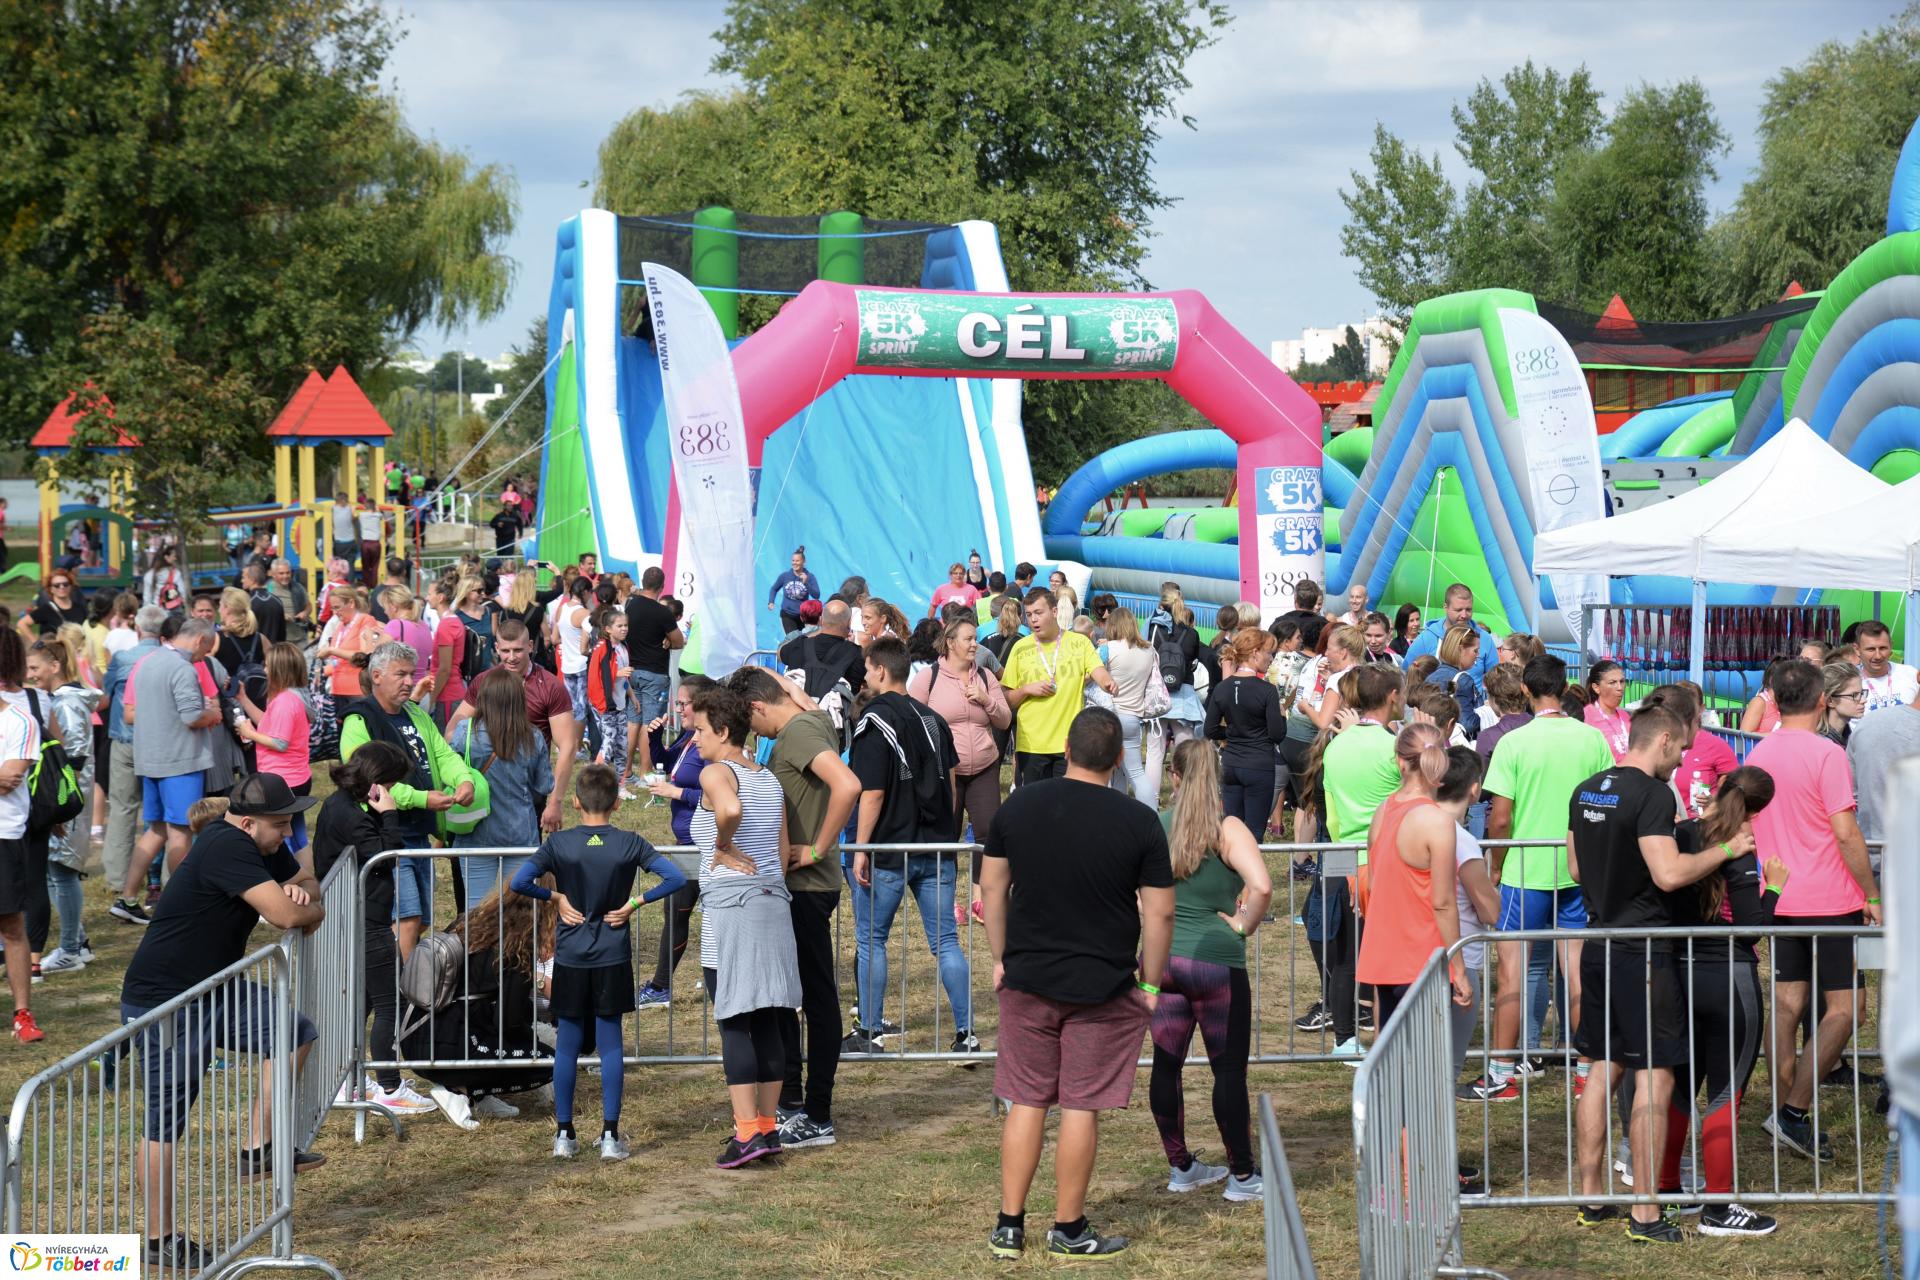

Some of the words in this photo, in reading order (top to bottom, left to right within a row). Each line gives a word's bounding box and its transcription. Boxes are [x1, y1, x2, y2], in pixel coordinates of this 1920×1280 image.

[865, 301, 920, 313] CRAZY
[1112, 308, 1168, 321] CRAZY
[877, 314, 913, 334] 5K
[957, 303, 1086, 361] CÉL
[1123, 321, 1160, 343] 5K
[868, 341, 919, 354] SPRINT
[1113, 348, 1166, 364] SPRINT
[1271, 469, 1321, 483] CRAZY
[1282, 483, 1317, 505] 5K
[1274, 517, 1321, 531] CRAZY
[1285, 530, 1317, 551] 5K
[1579, 791, 1620, 805] FINISHER
